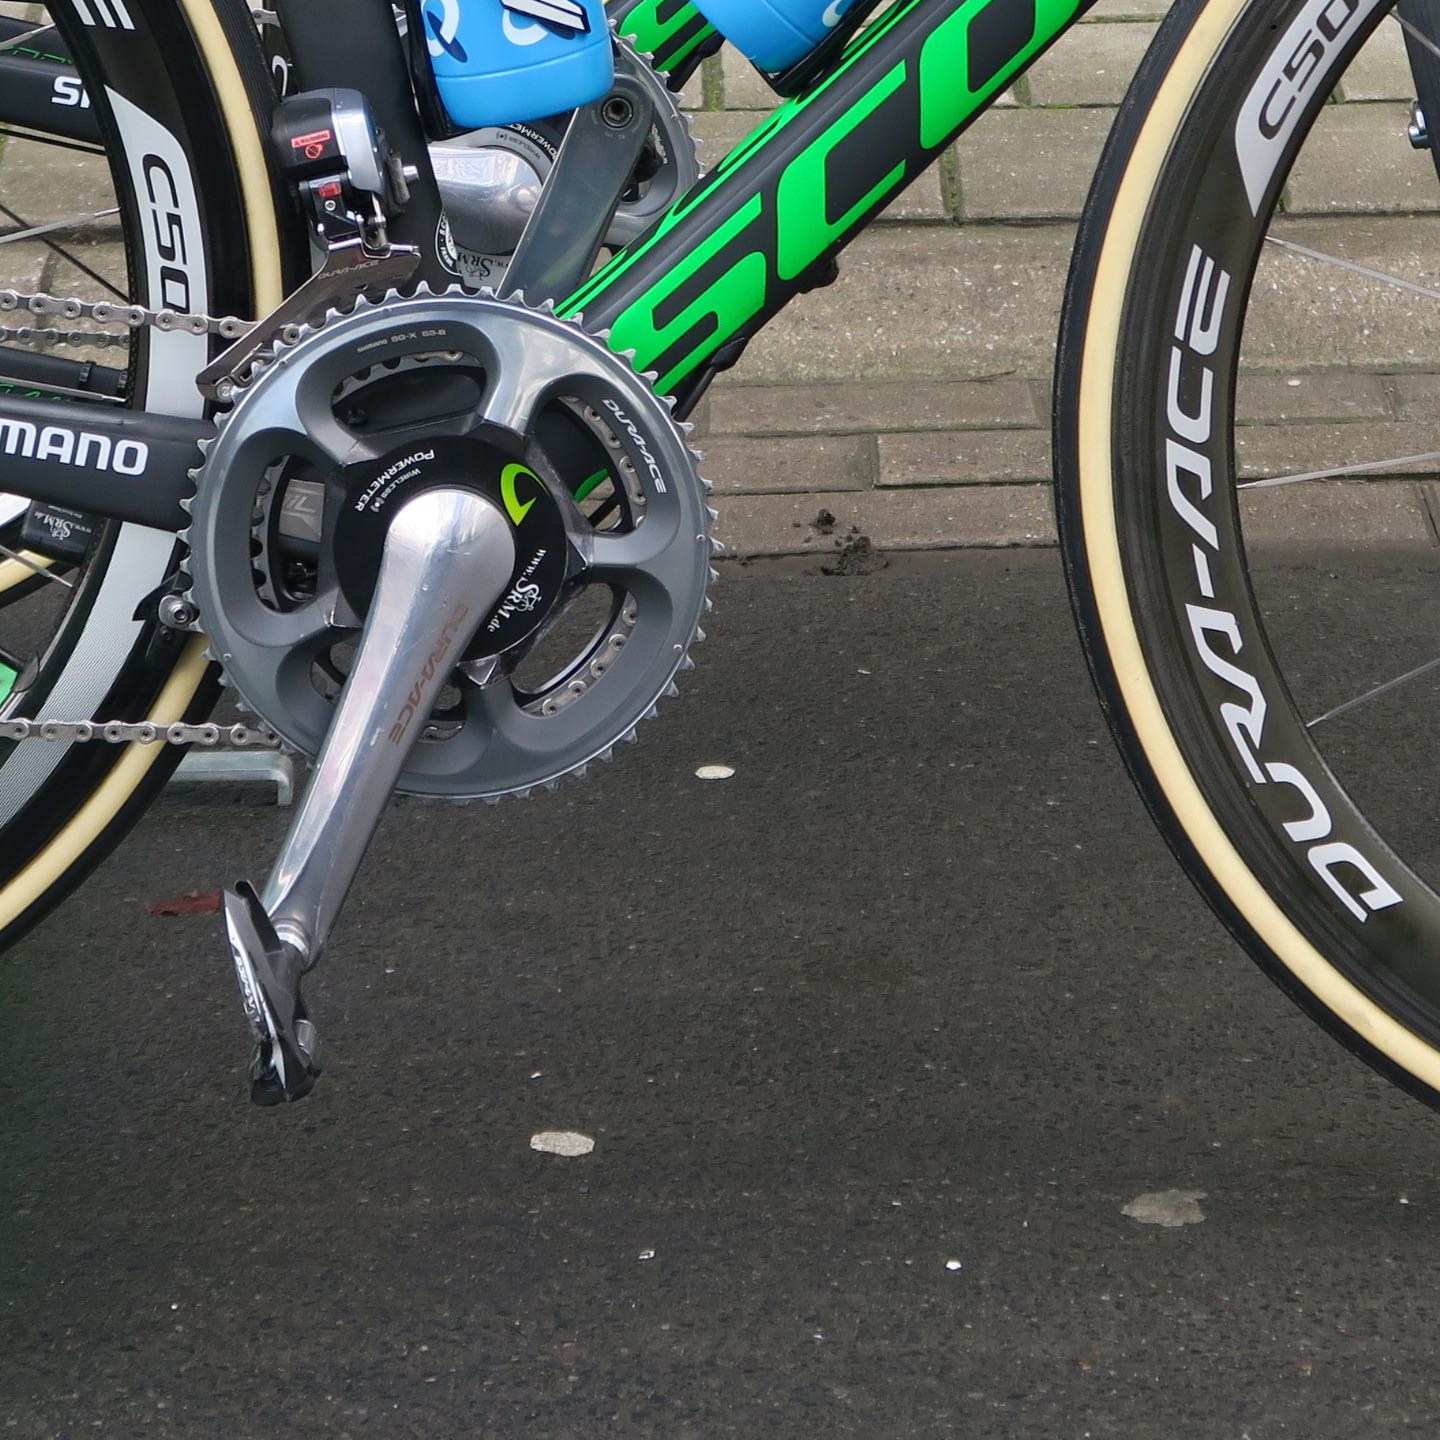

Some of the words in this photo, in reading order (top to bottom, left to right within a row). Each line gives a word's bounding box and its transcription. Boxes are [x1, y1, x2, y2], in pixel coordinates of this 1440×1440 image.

[143, 154, 190, 315] C50
[317, 259, 381, 280] DURA-ACE
[390, 331, 417, 344] SG-X
[602, 398, 668, 495] DURA-ACE
[487, 548, 547, 633] www.SRM.de
[1162, 243, 1403, 924] DURA-ACE
[387, 604, 470, 746] DURA-ACE
